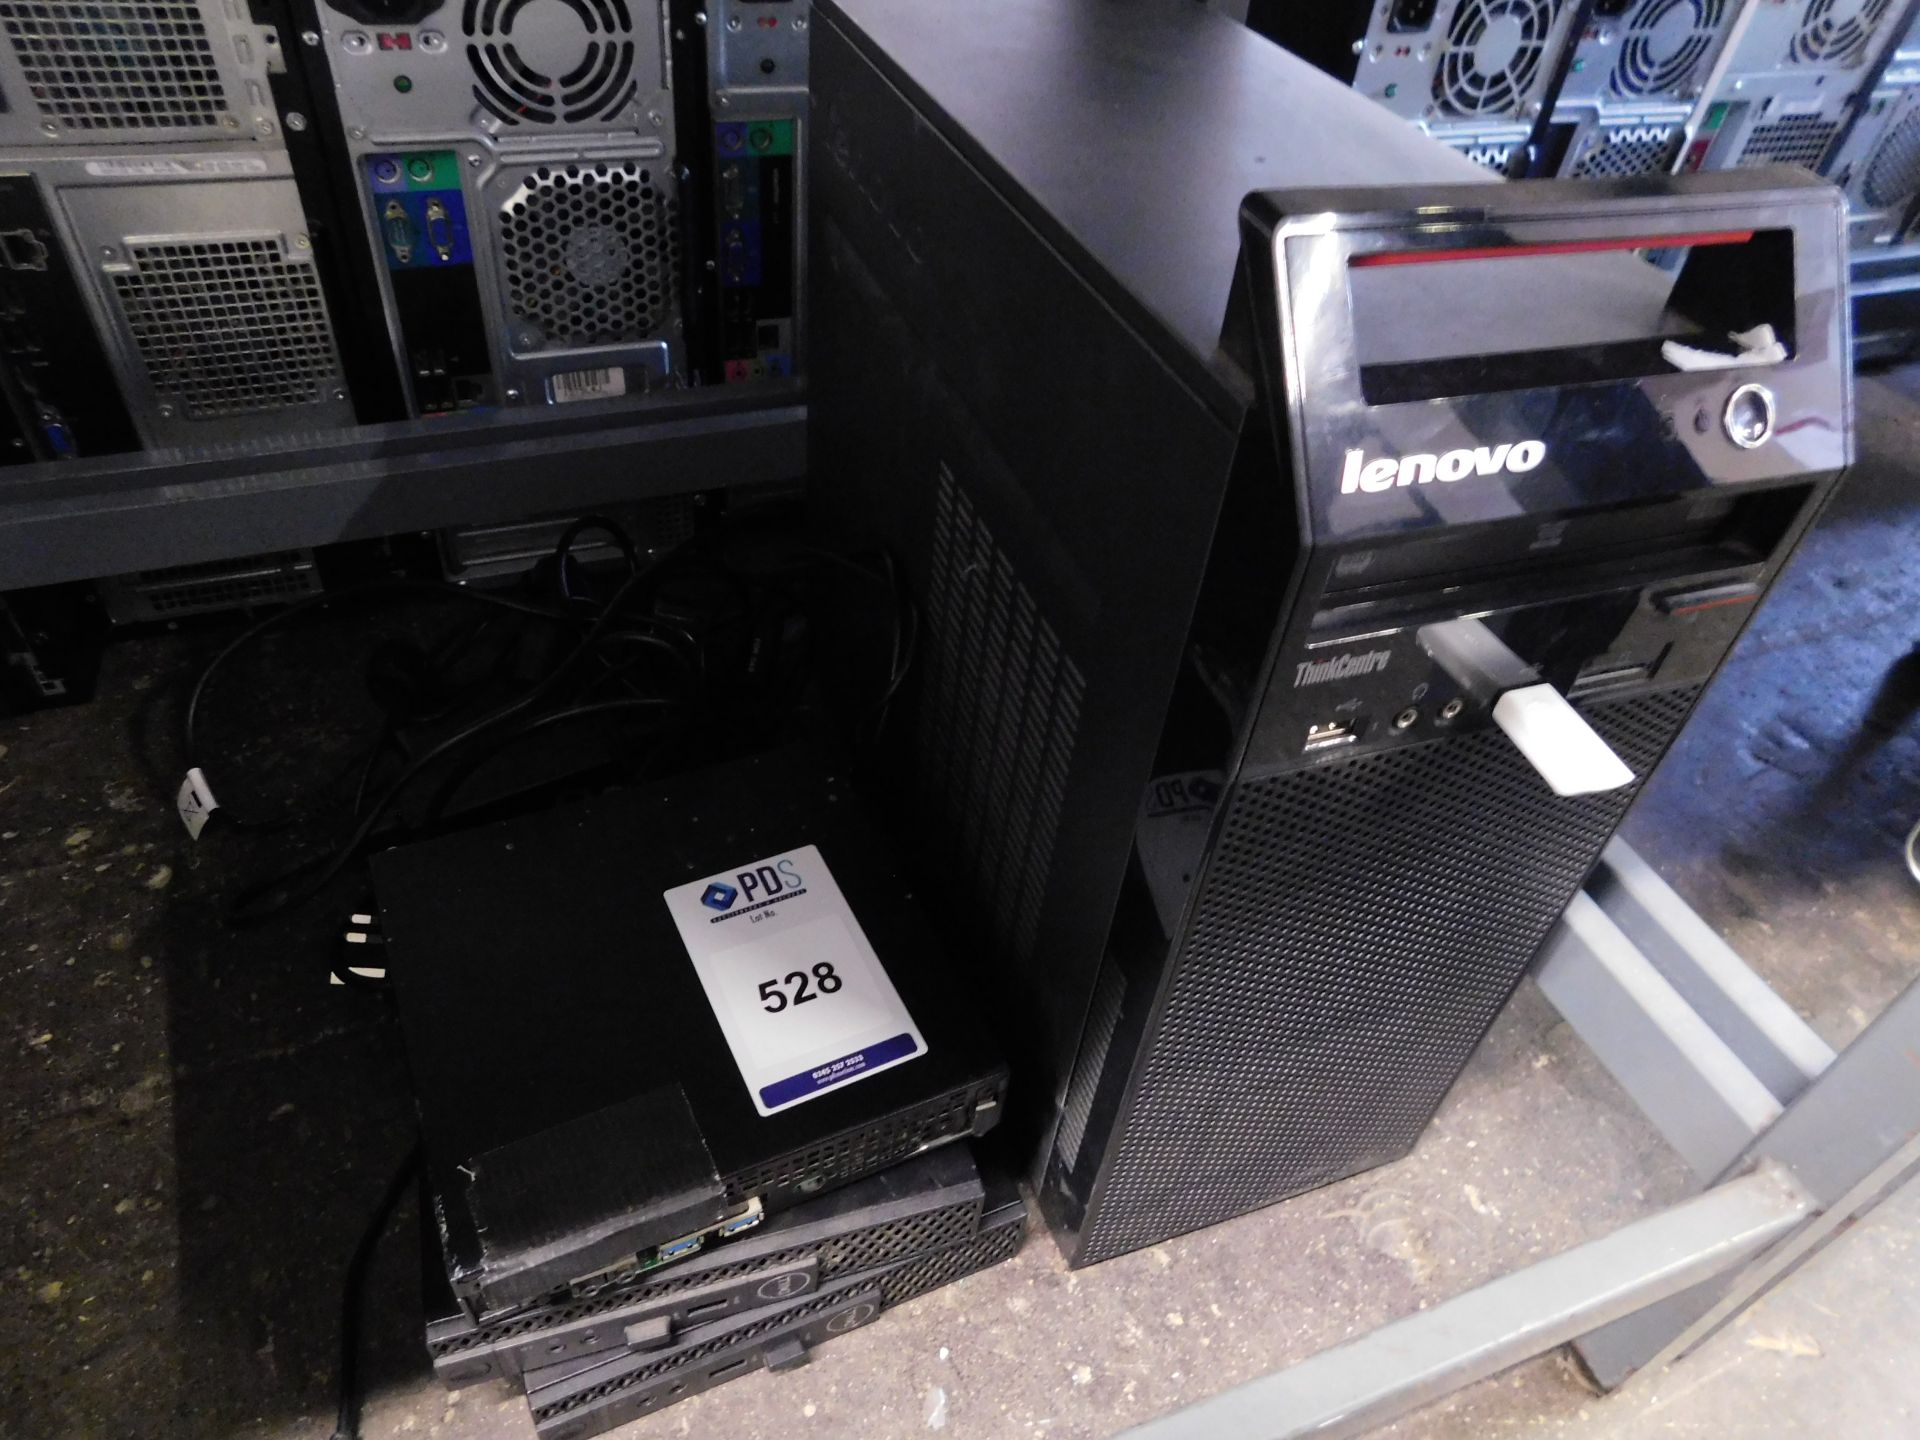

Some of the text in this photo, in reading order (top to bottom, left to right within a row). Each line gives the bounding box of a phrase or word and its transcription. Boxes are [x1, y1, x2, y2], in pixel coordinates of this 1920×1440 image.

[1341, 440, 1547, 494] lenovo
[1294, 650, 1392, 688] ThinkCentre
[736, 860, 803, 902] PDS
[758, 962, 842, 1013] 528
